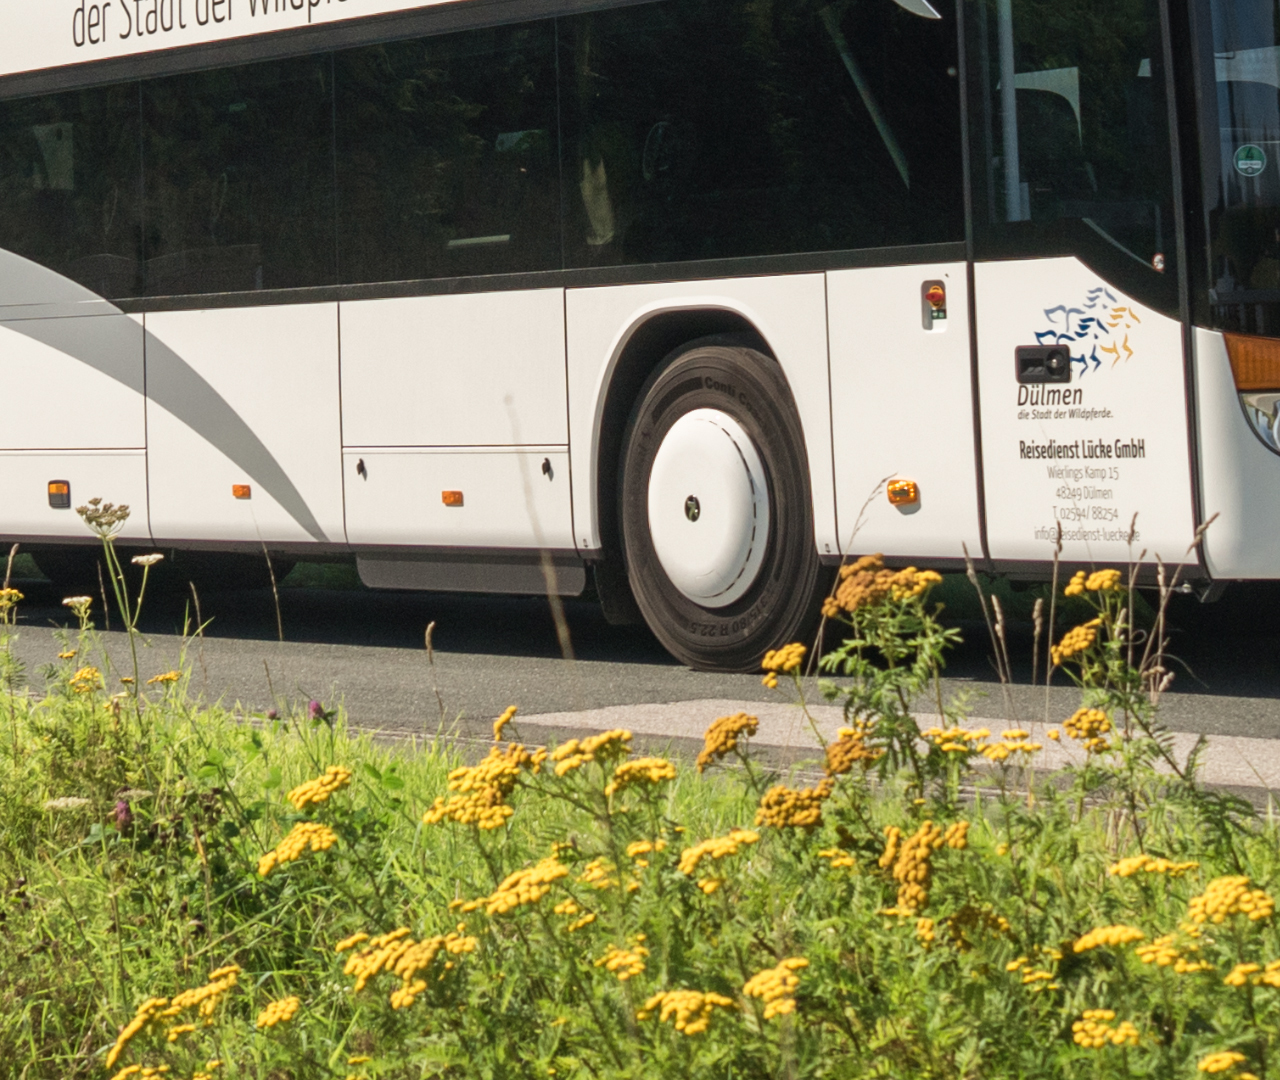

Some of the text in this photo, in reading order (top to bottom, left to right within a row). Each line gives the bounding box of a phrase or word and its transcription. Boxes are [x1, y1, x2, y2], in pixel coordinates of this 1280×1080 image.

[1017, 384, 1083, 407] Dülmen
[1018, 408, 1114, 421] die Stadt der Wildpferde.
[1019, 438, 1146, 460] Reisedienst Lücke GmbH
[1047, 465, 1120, 482] Wierlings Kamp 15
[1056, 485, 1113, 501] 48249 Dülmen
[1092, 506, 1119, 521] 88254
